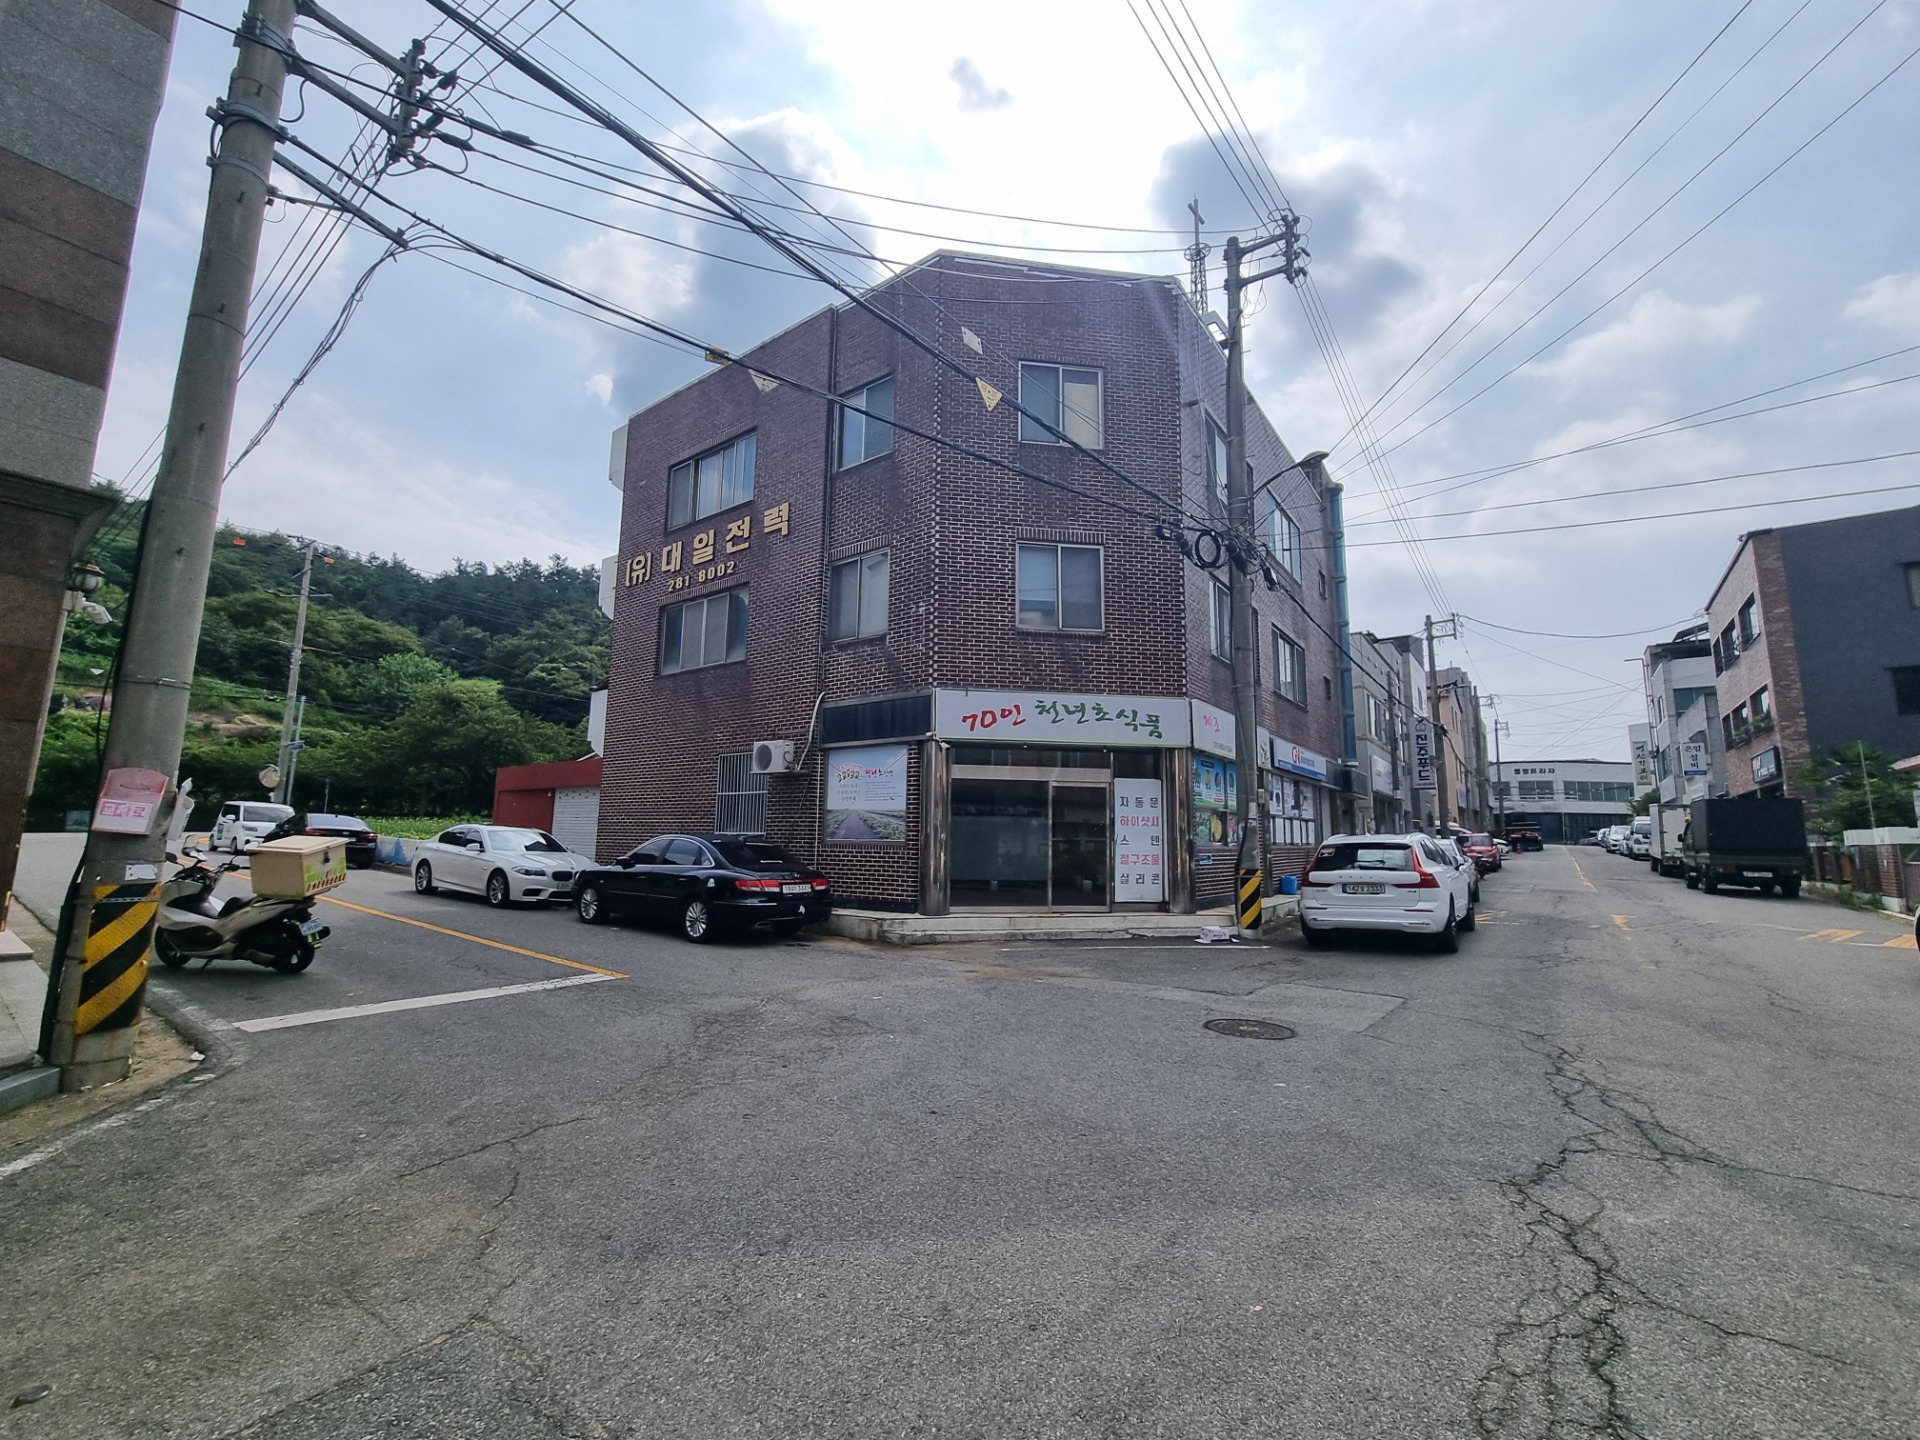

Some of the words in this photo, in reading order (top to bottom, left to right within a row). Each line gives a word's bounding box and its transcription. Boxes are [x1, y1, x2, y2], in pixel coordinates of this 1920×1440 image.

[661, 502, 790, 573] 대일전력
[668, 575, 690, 593] 281
[699, 560, 735, 582] 8002
[961, 704, 1027, 732] 70인
[1034, 699, 1164, 739] 천년초식품
[1415, 733, 1431, 781] 진주푸드
[1119, 796, 1160, 809] 자동문
[1119, 853, 1160, 866] 철구조물
[1119, 872, 1160, 885] 실리콘
